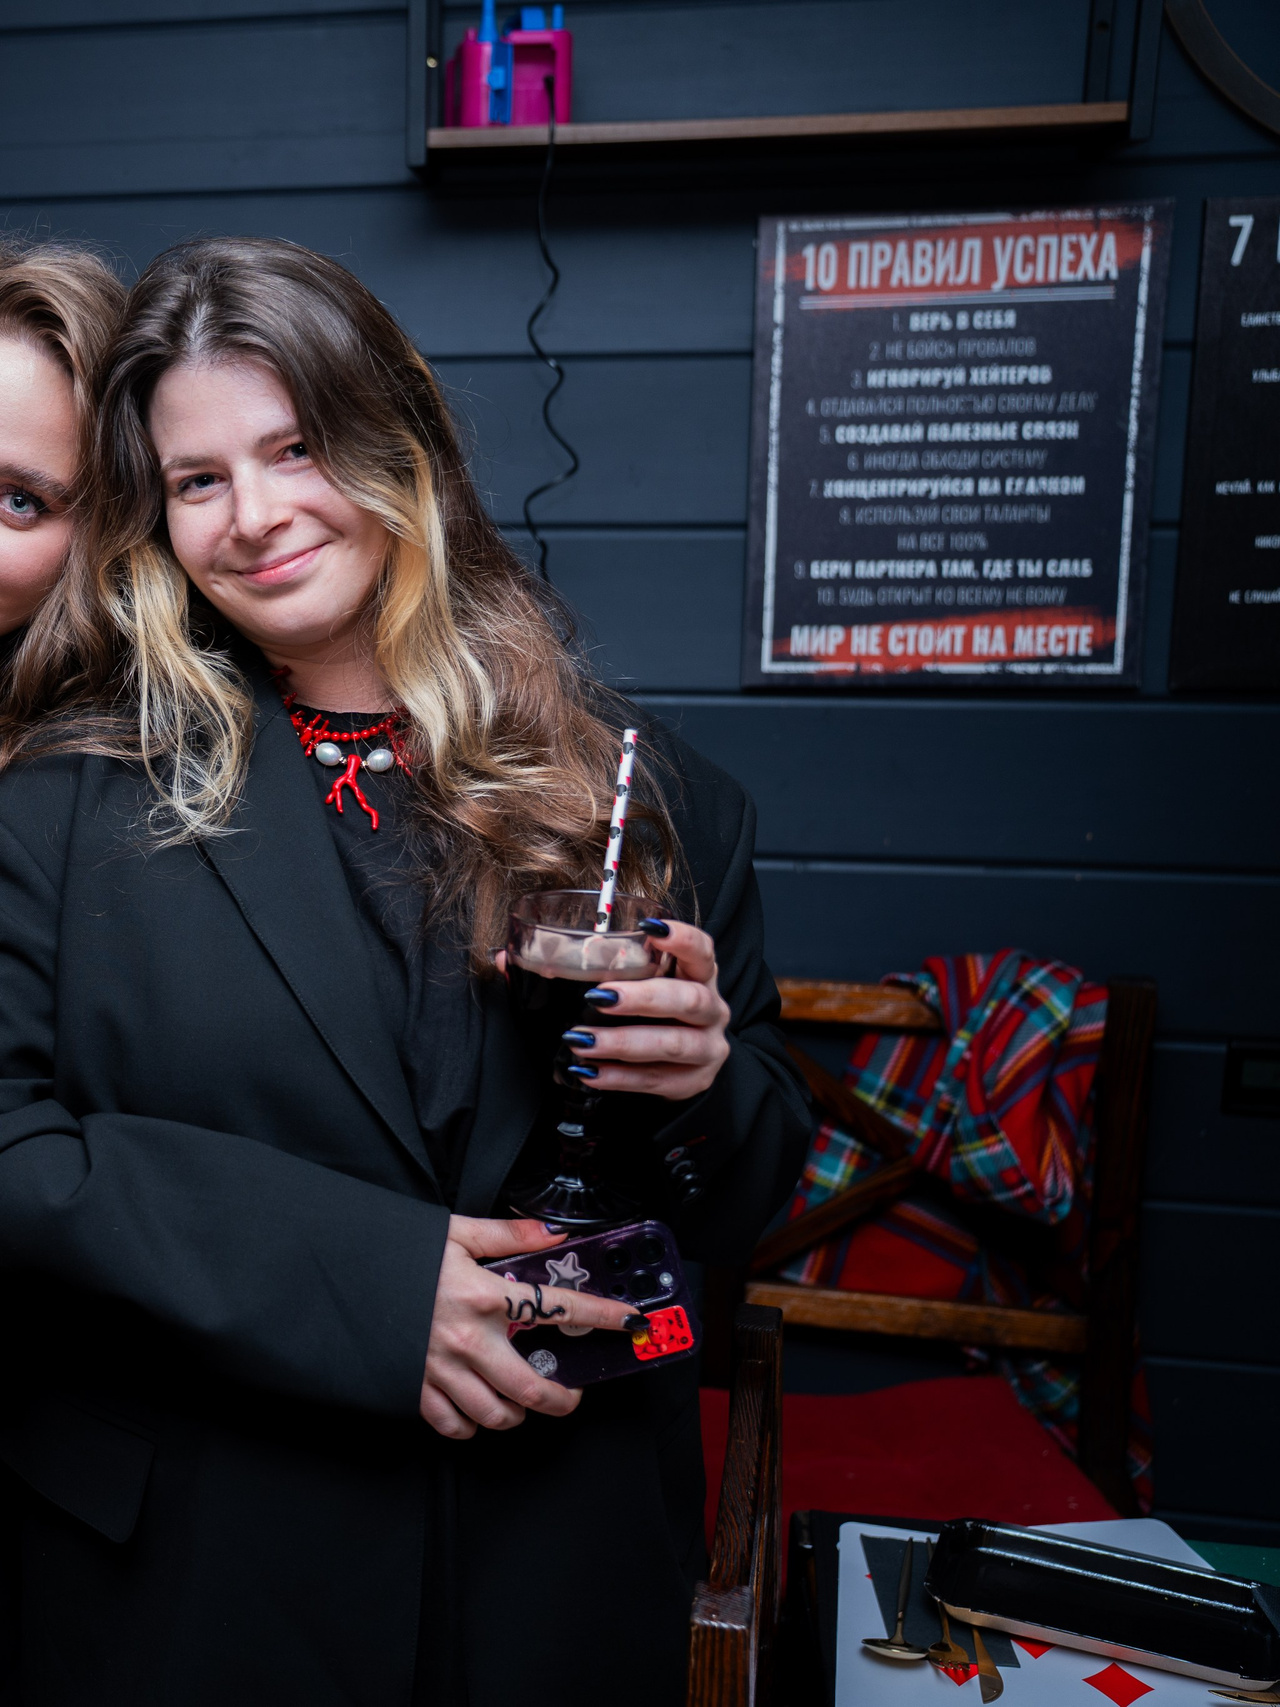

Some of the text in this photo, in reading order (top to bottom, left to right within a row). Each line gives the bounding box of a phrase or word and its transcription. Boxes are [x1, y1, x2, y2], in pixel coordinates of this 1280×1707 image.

[1228, 214, 1255, 267] 7
[803, 232, 1119, 292] 10 ПРАВИЛ УСПЕХА
[909, 311, 953, 332] ВЕРЬ
[956, 310, 969, 330] В
[972, 309, 1017, 330] СЕБЯ
[885, 340, 904, 360] НЕ
[958, 336, 1037, 359] ПРОВАЛОВ
[867, 364, 967, 390] ИГНОРИРУЙ
[969, 362, 1053, 387] ХЕЙТЕРОВ
[820, 393, 905, 418] ОТДАВАЙСЯ
[998, 391, 1057, 414] СВОЕМУ
[835, 420, 924, 446] СОЗДАВАЙ
[927, 420, 1019, 442] ПОЛЕЗНЫЕ
[1021, 419, 1080, 441] СВЯЗИ
[863, 449, 920, 472] ИНОГДА
[921, 448, 980, 471] ОБХОДИ
[981, 447, 1048, 470] СИСТЕМУ
[823, 474, 975, 501] КОНЦЕНТРИРУЙСЯ
[978, 476, 1002, 497] НА
[1004, 475, 1086, 497] ГЛАВНОМ
[855, 502, 940, 526] ИСПОЛЬЗУЙ
[941, 503, 982, 525] СВОИ
[984, 502, 1052, 524] ТАЛАНТЫ
[897, 530, 989, 552] НА ВСЕ 100%
[810, 559, 853, 580] БЕРИ
[854, 559, 938, 579] ПАРТНЕРА
[982, 558, 1014, 581] ГДЕ
[1017, 558, 1043, 578] ТЫ
[1046, 558, 1094, 578] СЛАБ
[838, 586, 876, 607] БУДЬ
[876, 585, 933, 606] ОТКРЫТ
[956, 585, 1005, 606] ВСЕМУ
[790, 624, 1094, 657] МИР НЕ СТОИТ НА МЕСТЕ
